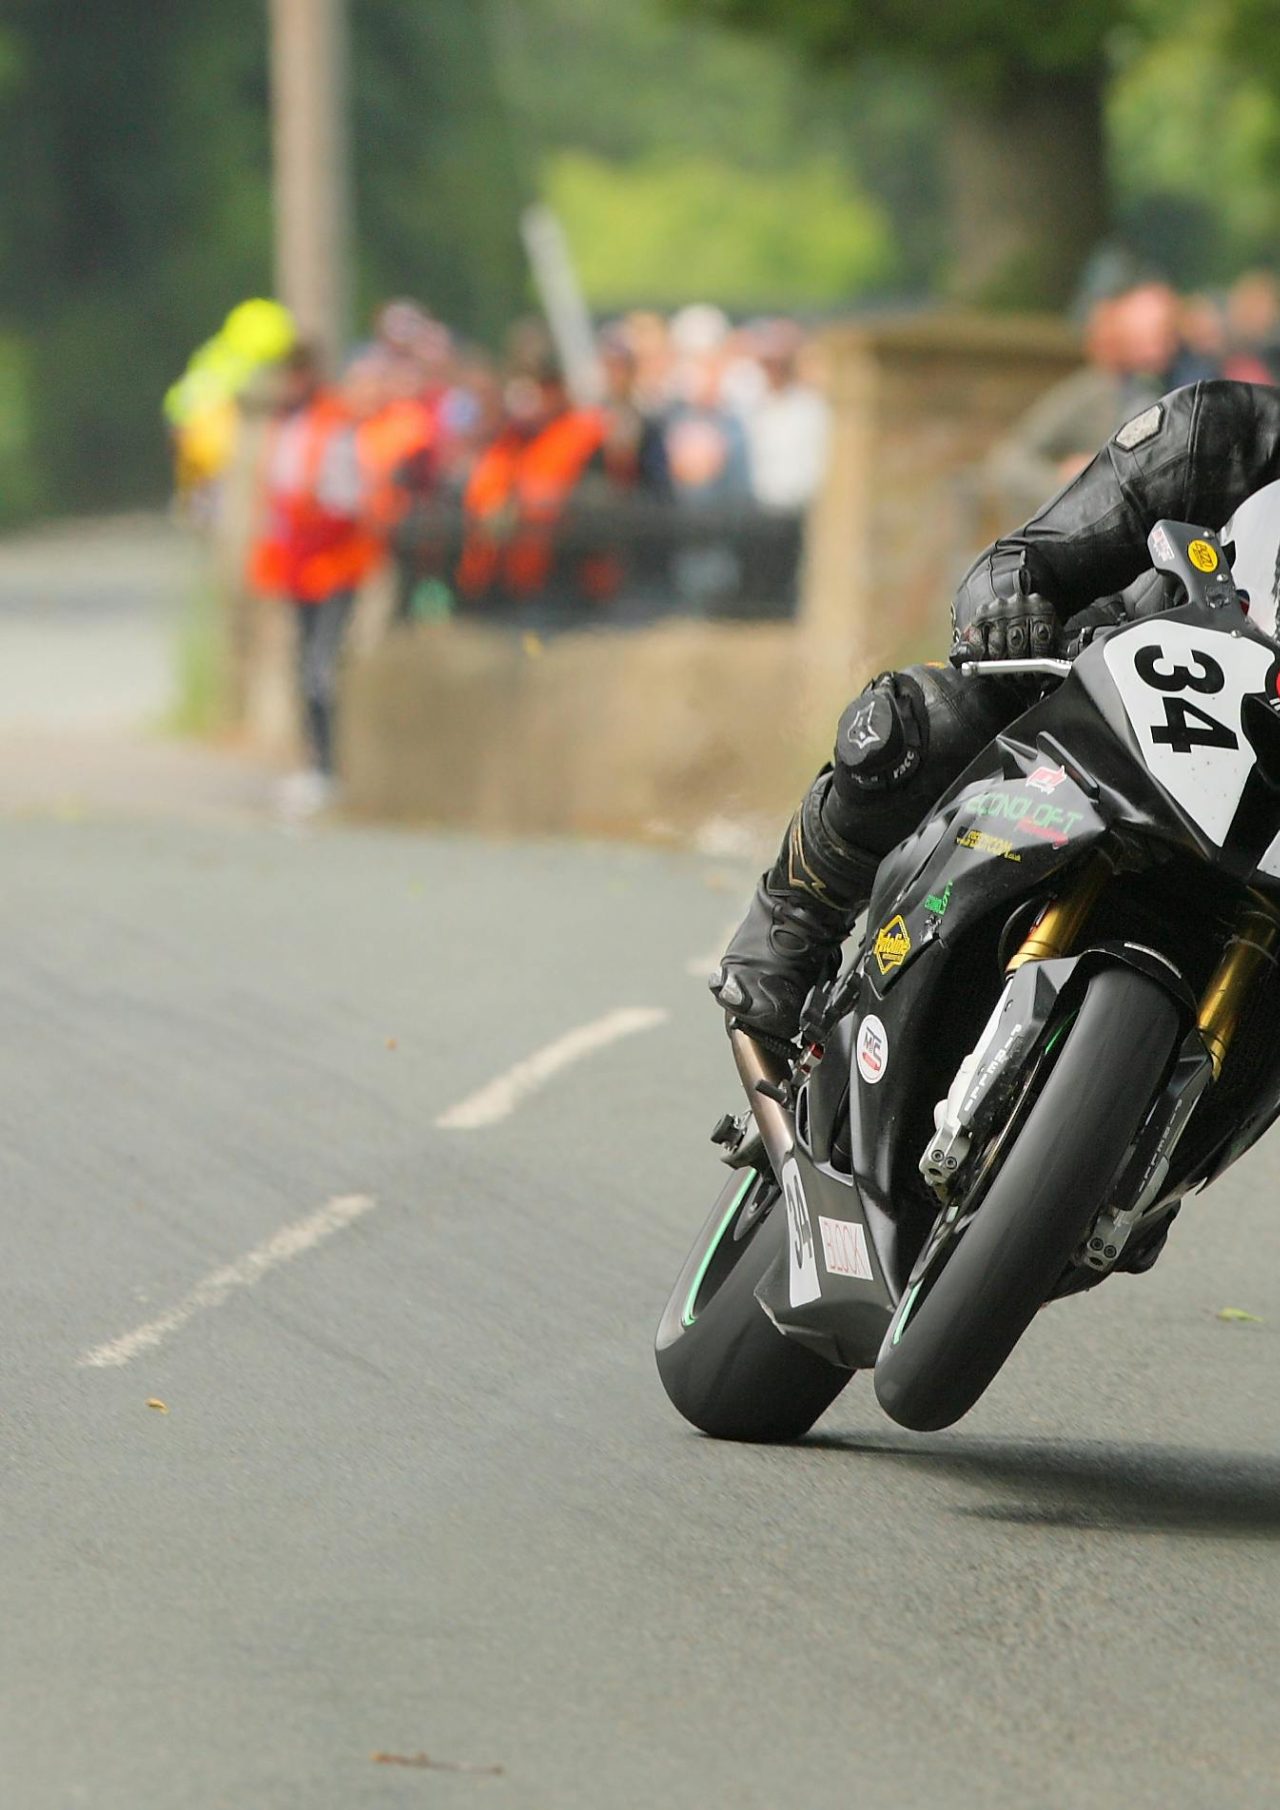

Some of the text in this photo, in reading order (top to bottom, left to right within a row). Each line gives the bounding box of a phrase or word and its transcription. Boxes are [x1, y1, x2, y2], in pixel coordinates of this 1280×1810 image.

[1134, 645, 1239, 753] 34
[964, 1024, 1022, 1111] PIRELLI
[786, 1175, 813, 1269] 34
